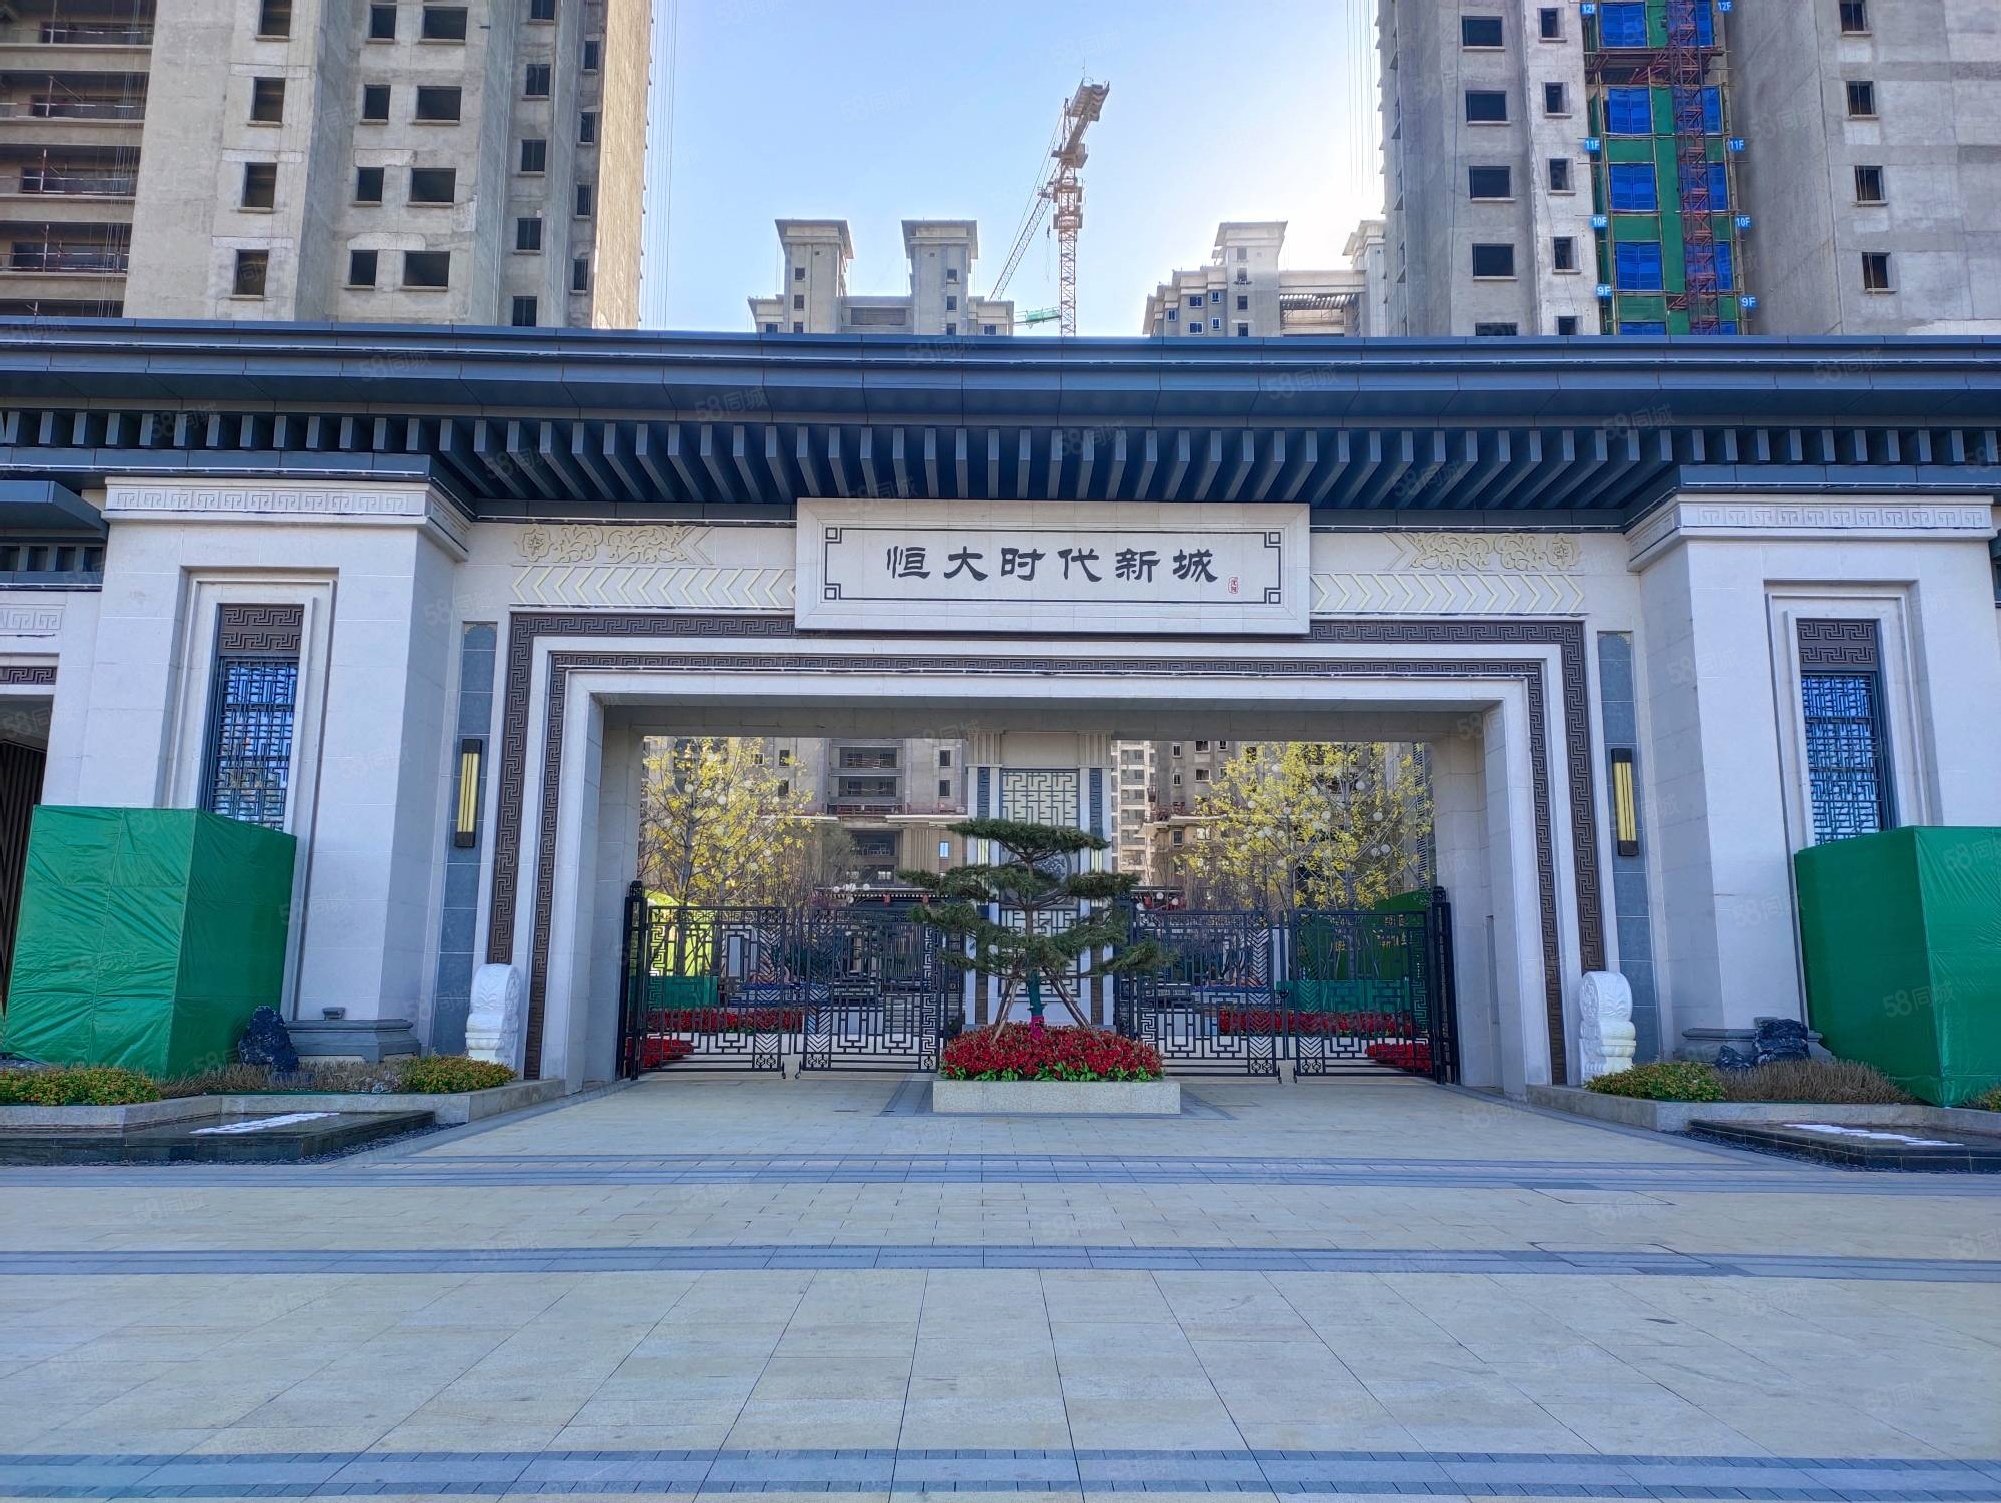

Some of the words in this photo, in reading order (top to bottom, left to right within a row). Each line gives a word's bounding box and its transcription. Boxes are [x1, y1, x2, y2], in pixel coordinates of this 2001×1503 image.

[1718, 2, 1732, 12] 12F
[1585, 139, 1600, 150] 11F
[1730, 139, 1744, 150] 11F
[1593, 216, 1607, 226] 10F
[1736, 217, 1750, 227] 10F
[1597, 286, 1612, 296] 9F
[1741, 297, 1756, 307] 9F
[886, 545, 1218, 583] 恒大时代新城
